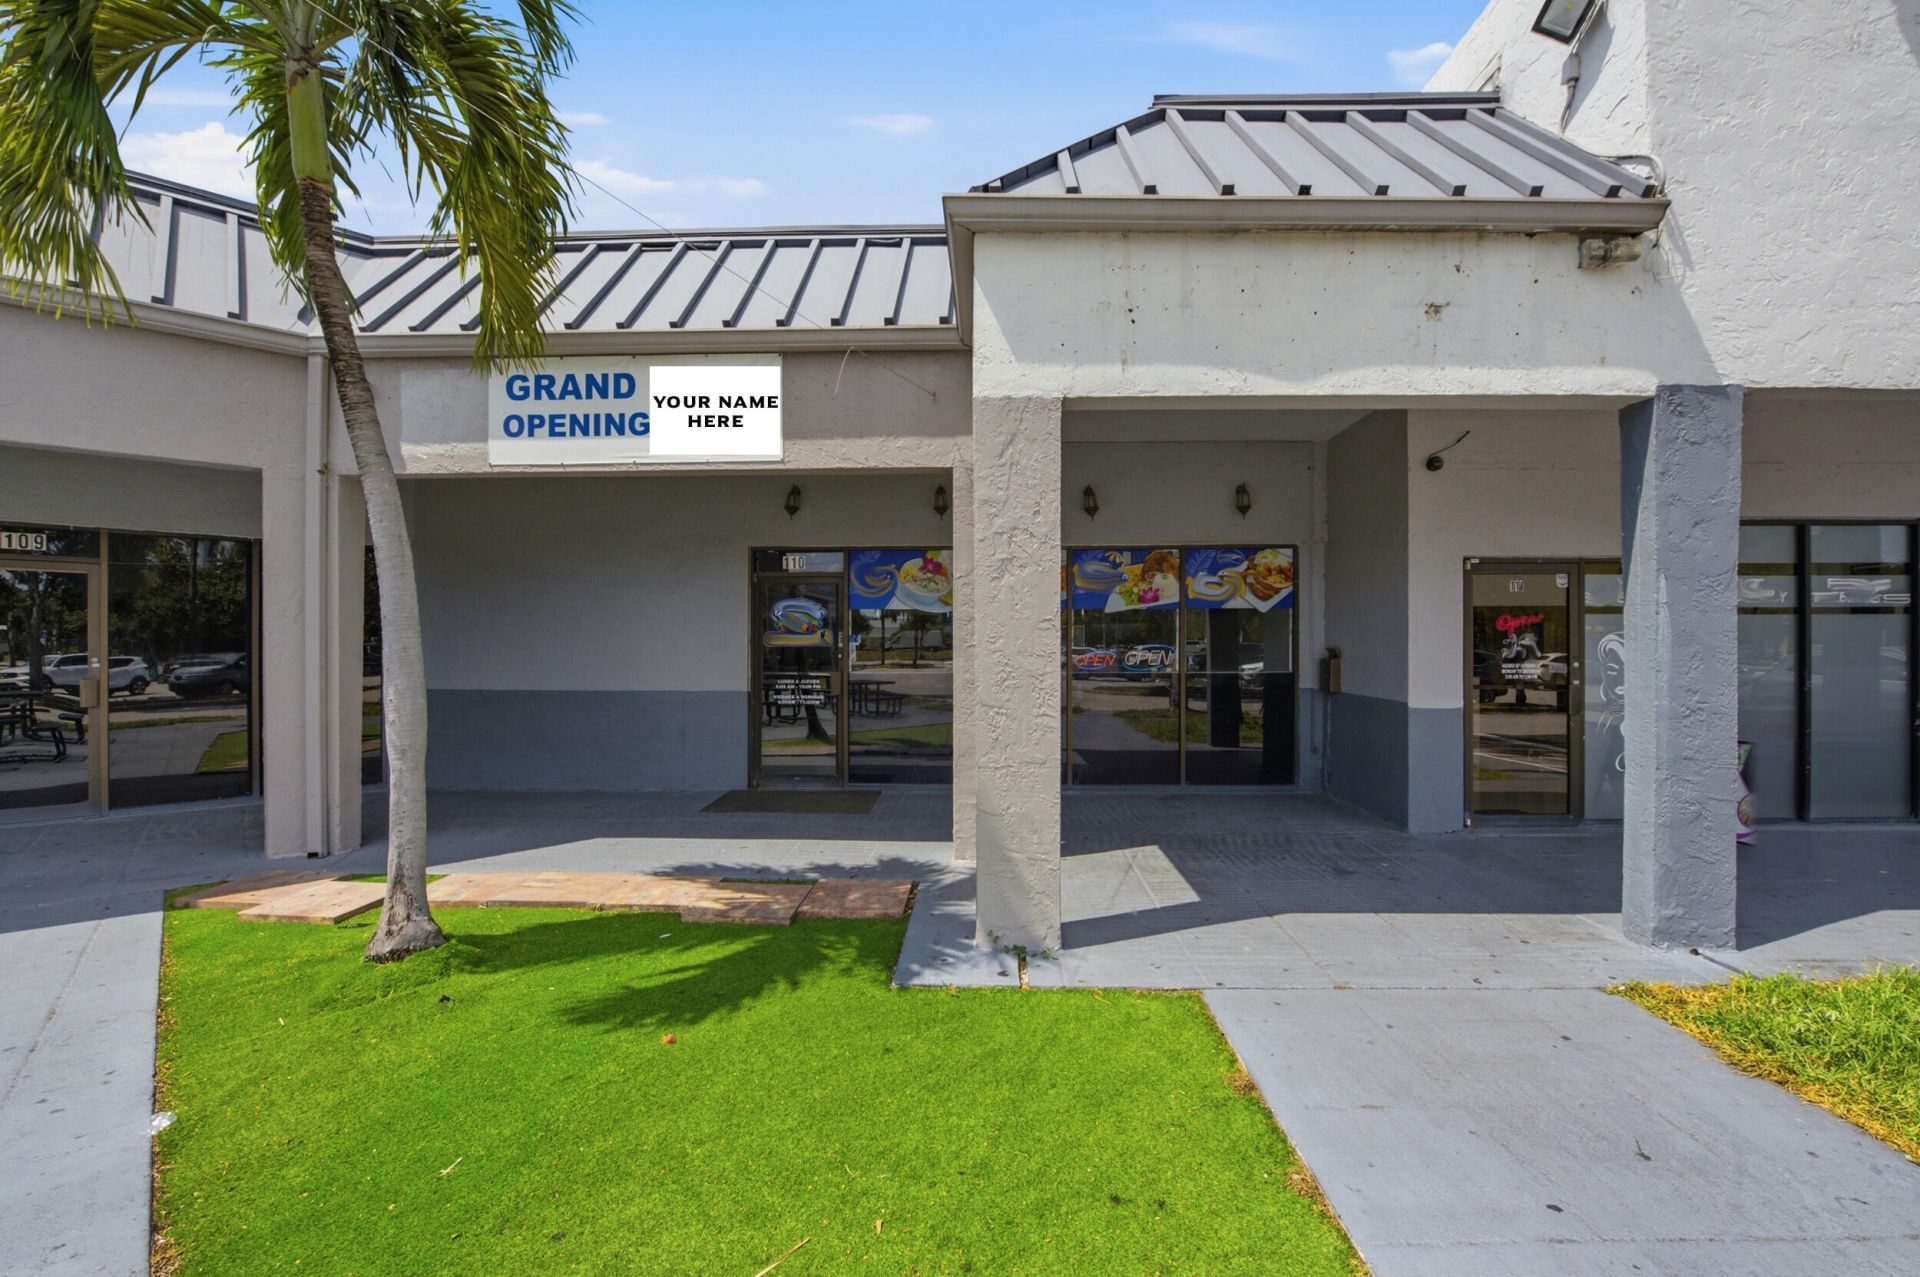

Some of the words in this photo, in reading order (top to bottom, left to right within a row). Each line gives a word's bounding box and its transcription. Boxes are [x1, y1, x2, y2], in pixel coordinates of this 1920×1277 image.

[505, 372, 637, 401] GRAND
[502, 412, 650, 438] OPENING
[4, 533, 44, 550] 109
[784, 556, 805, 569] 110
[1074, 654, 1117, 666] OPEN
[1124, 650, 1173, 667] OPEN
